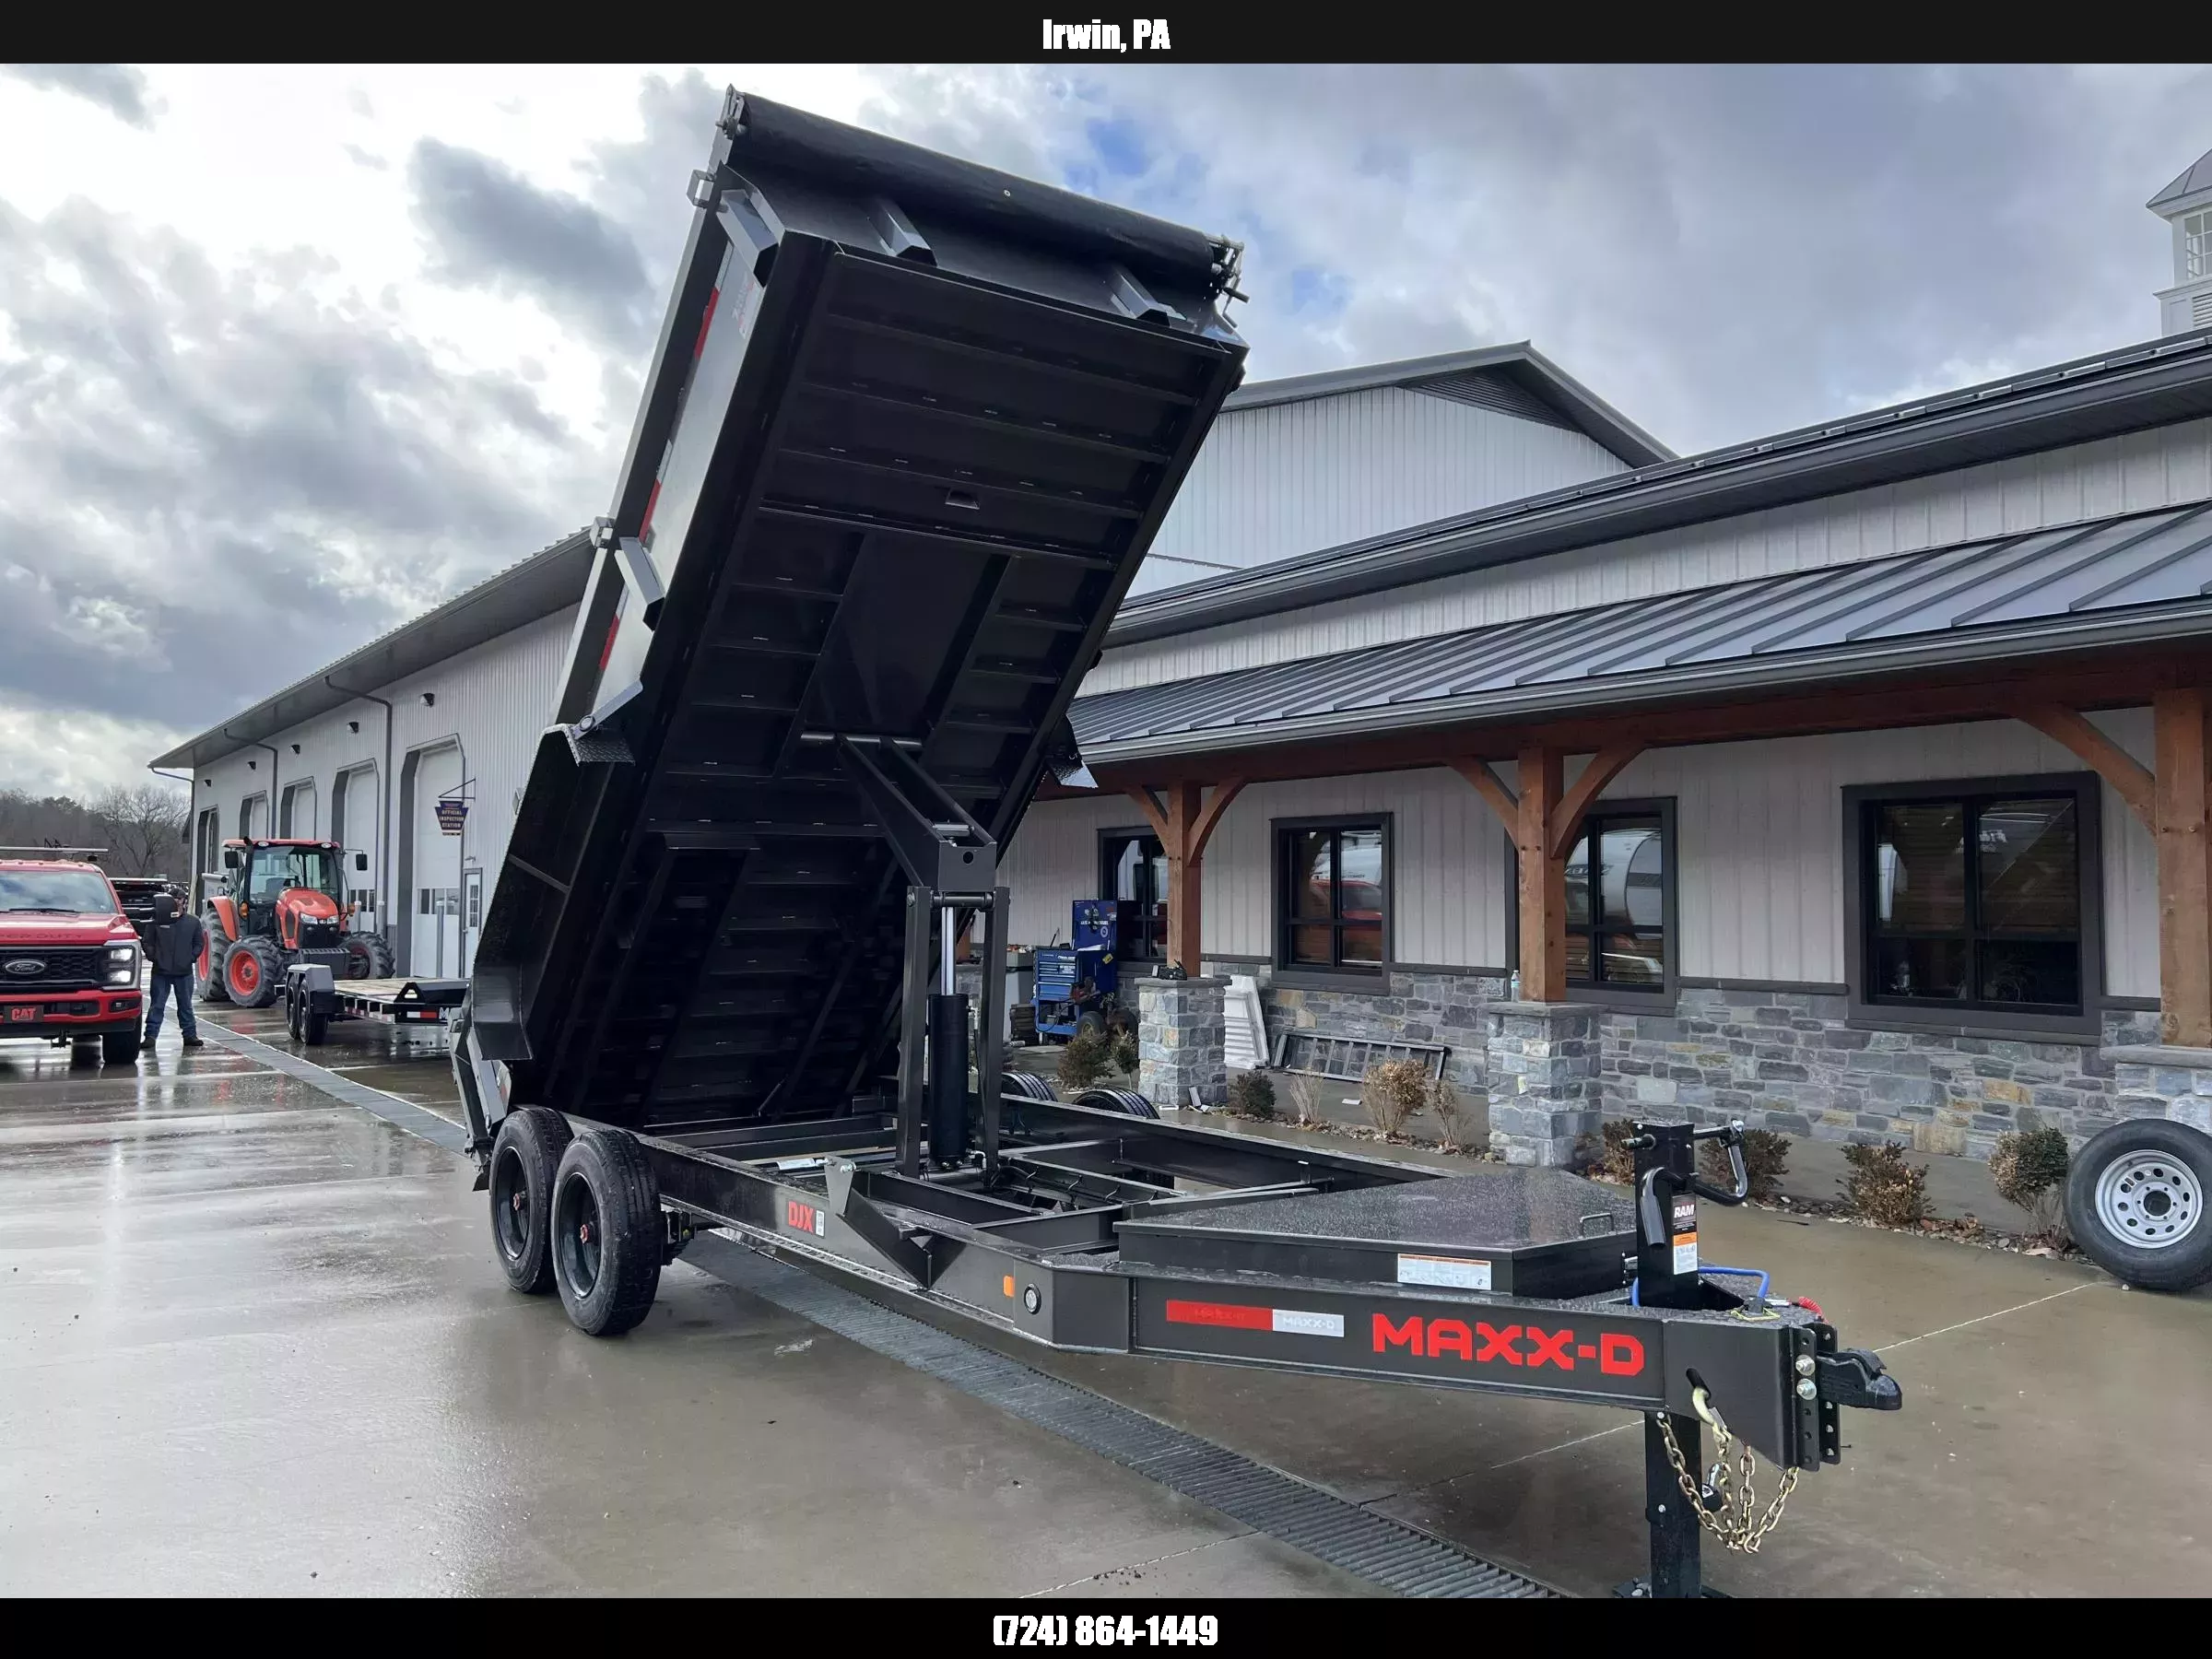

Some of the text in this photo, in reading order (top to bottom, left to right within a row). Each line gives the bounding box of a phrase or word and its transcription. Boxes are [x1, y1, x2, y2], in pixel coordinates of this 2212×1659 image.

[11, 1007, 36, 1021] CAT
[788, 1200, 814, 1234] DJX
[1674, 1204, 1695, 1218] RAM
[1371, 1312, 1644, 1377] MAXX-D
